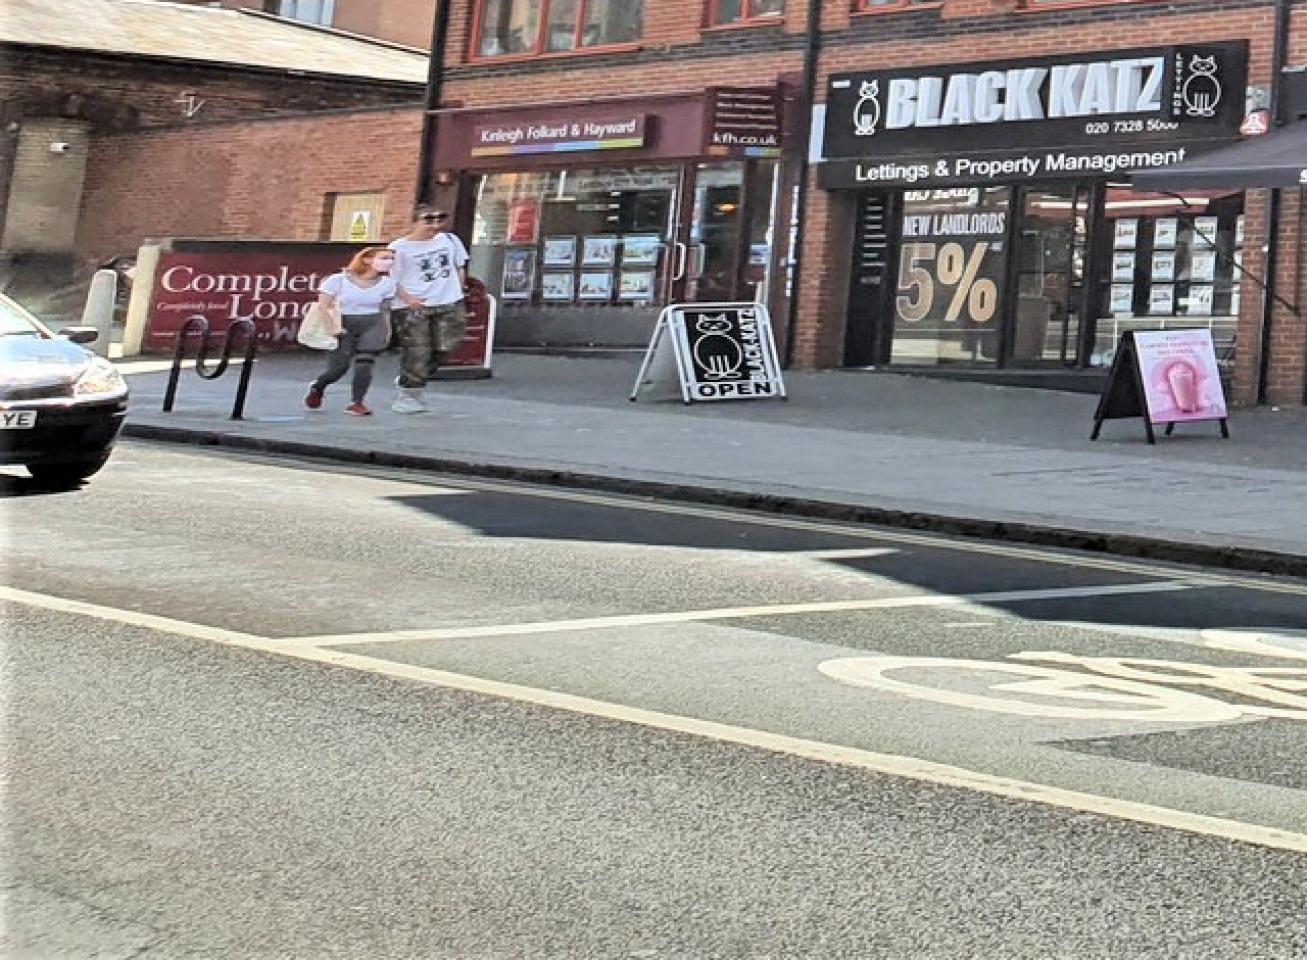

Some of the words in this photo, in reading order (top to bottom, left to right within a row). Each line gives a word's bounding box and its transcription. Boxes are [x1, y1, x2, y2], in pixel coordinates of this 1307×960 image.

[886, 68, 1048, 130] BLACK
[1047, 56, 1165, 117] KATZ
[481, 127, 523, 144] Kinleigh
[526, 124, 567, 140] Folkard
[571, 125, 581, 137] &
[583, 119, 637, 138] Hayward
[1086, 122, 1110, 134] 020
[1114, 120, 1143, 133] 7328
[855, 163, 929, 182] Lettings
[935, 160, 950, 177] &
[955, 153, 1040, 178] Property
[1045, 146, 1187, 173] Management
[902, 215, 932, 236] NEW
[933, 212, 1006, 235] LANDLORDS
[896, 242, 998, 322] 5%
[699, 381, 772, 397] OPEN
